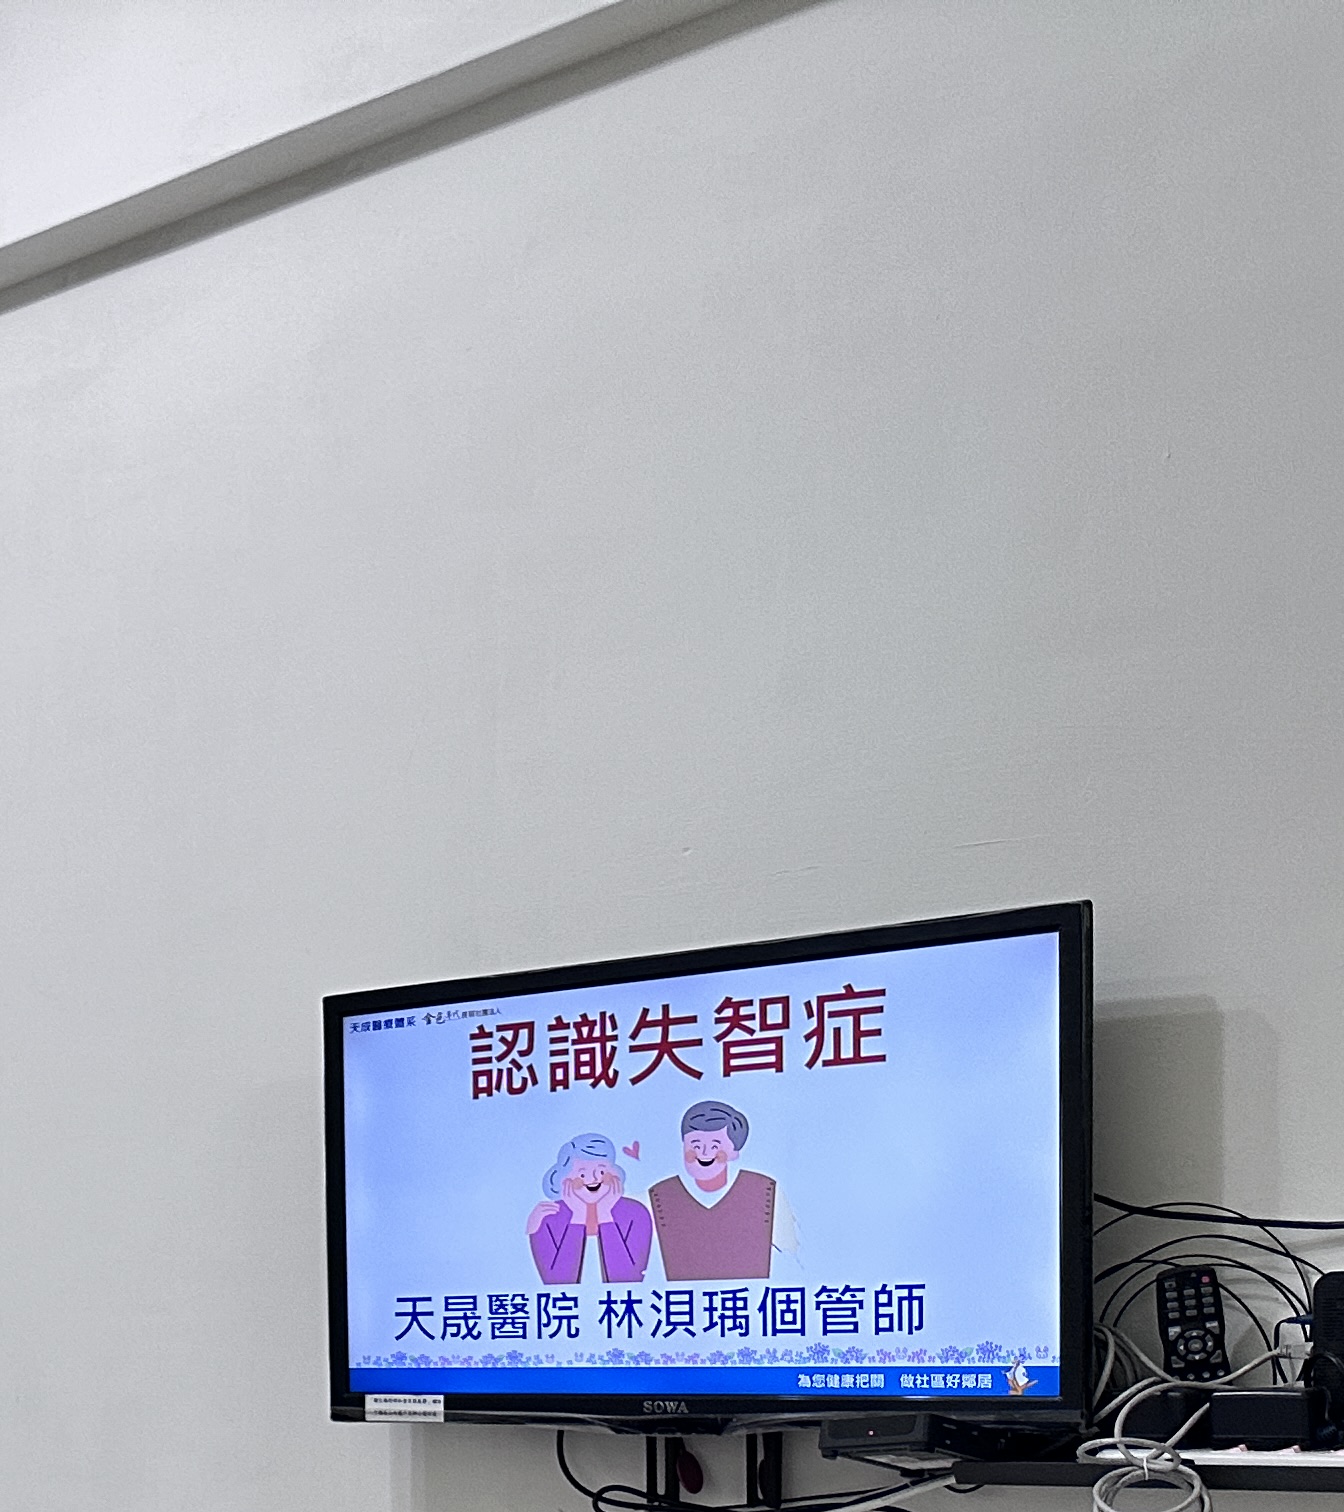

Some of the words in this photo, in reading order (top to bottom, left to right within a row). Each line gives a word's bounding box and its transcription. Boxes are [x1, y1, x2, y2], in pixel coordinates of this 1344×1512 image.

[469, 983, 888, 1100] 認識失智症
[393, 1292, 581, 1342] 天晟醫院
[598, 1282, 927, 1340] 林浿瑀個管師
[797, 1373, 885, 1389] 為您健康把關
[899, 1373, 993, 1389] 做社區好鄰居
[642, 1400, 689, 1414] SOWA
